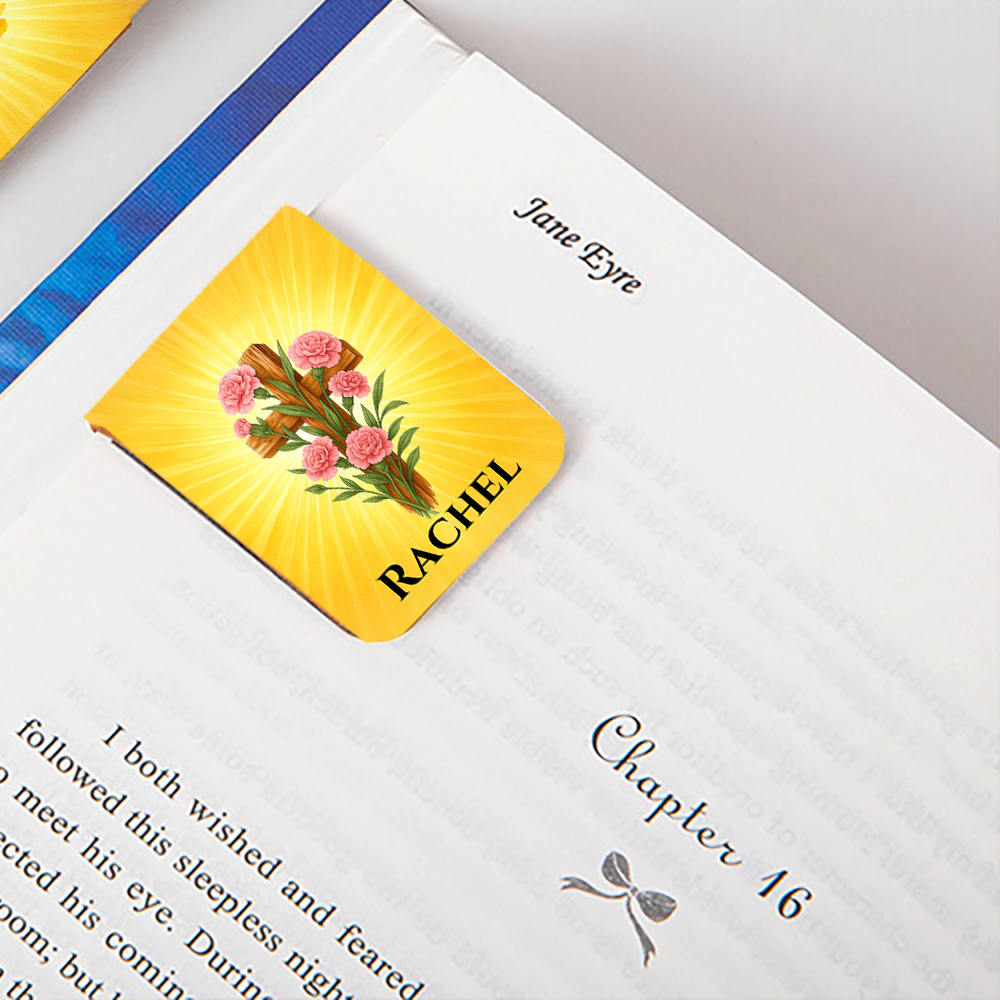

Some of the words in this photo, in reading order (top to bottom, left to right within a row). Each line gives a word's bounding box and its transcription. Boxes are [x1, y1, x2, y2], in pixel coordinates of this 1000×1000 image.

[512, 197, 582, 248] Jane
[577, 241, 643, 294] Eyre
[376, 458, 524, 602] RACHEL
[13, 786, 80, 843] meet
[80, 836, 123, 881] his
[126, 881, 175, 933] eye.
[184, 926, 273, 1000] Durin
[16, 718, 128, 815] followed
[124, 810, 173, 857] this
[172, 854, 284, 953] sleepless
[283, 951, 355, 1000] nigh
[103, 723, 125, 747] I
[123, 740, 182, 801] both
[187, 797, 283, 881] wished
[280, 879, 337, 927] and
[336, 923, 425, 1000] feared
[591, 713, 743, 867] Chapter
[757, 868, 813, 920] 16
[59, 885, 102, 931] his
[105, 931, 194, 1000] comin
[59, 952, 104, 1000] but
